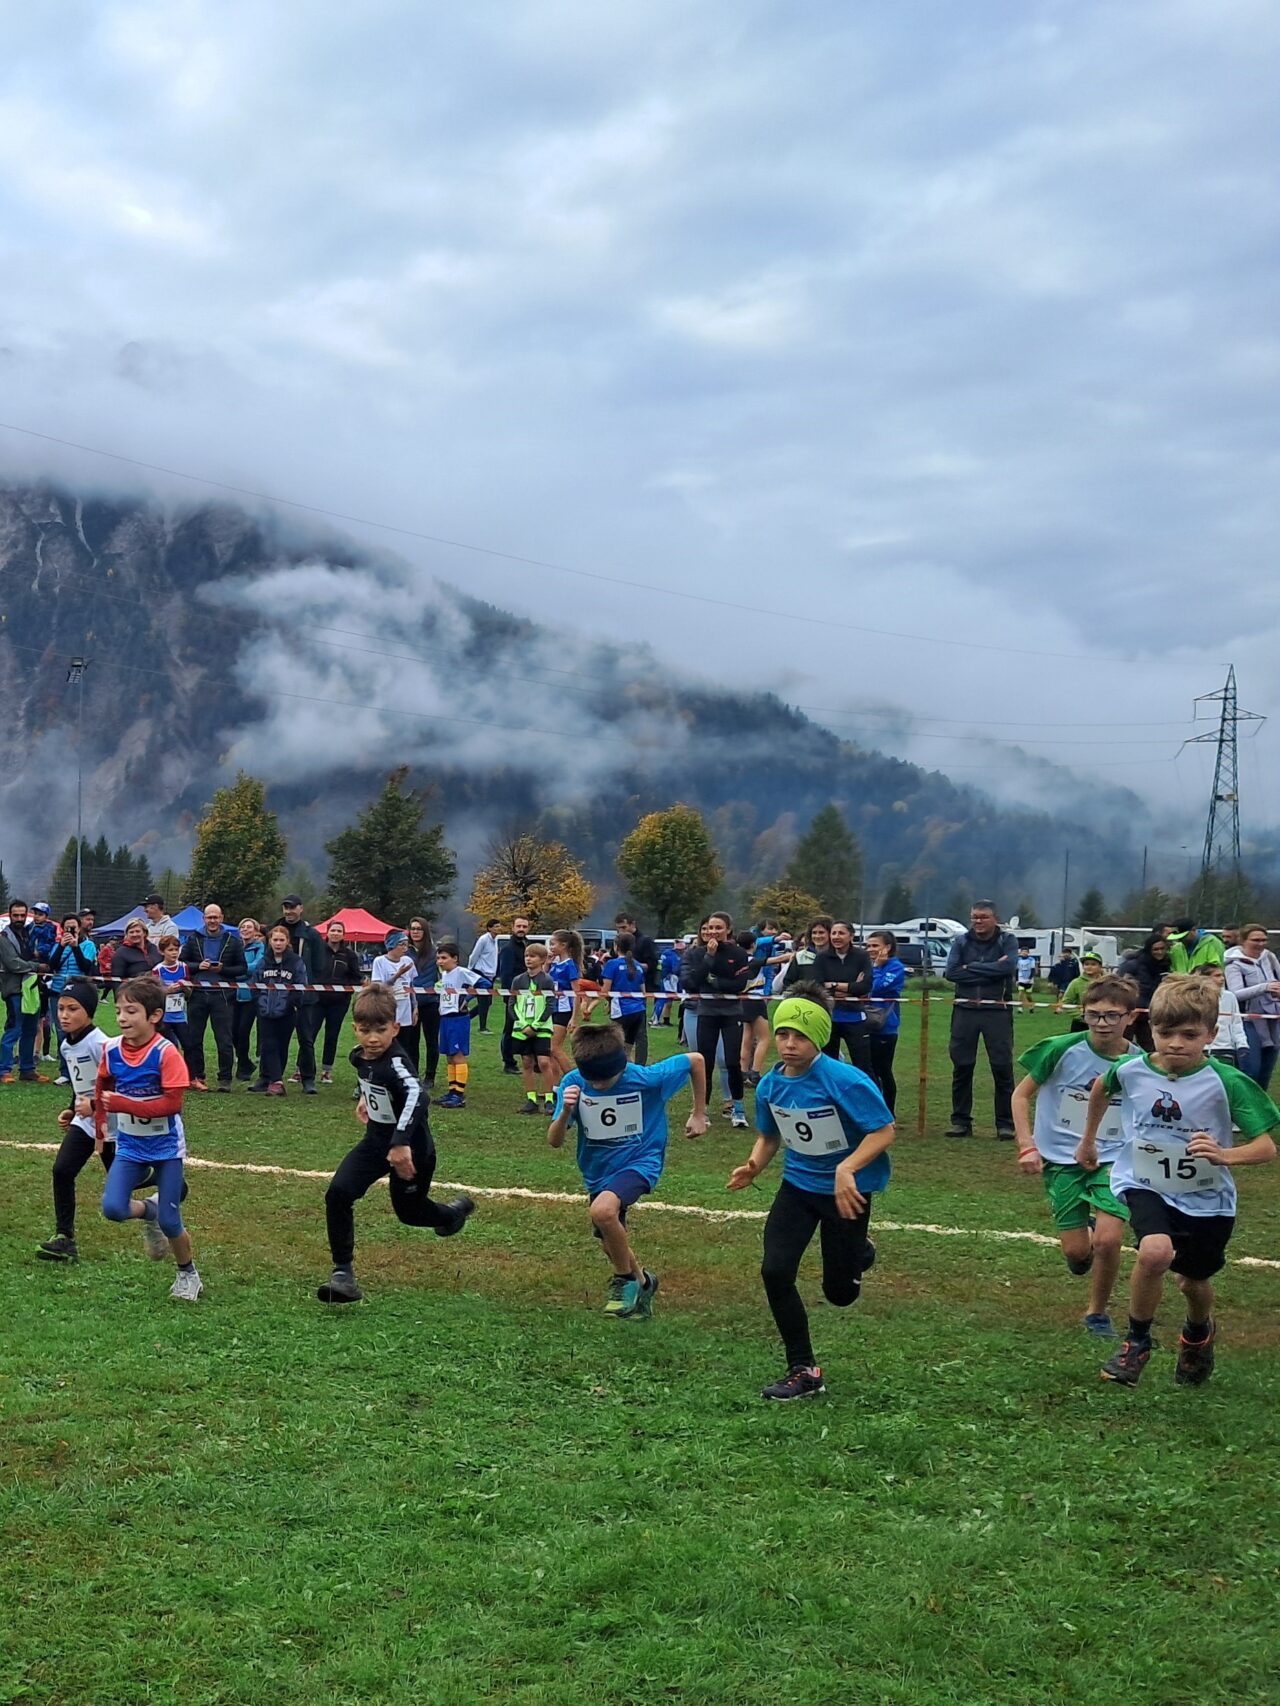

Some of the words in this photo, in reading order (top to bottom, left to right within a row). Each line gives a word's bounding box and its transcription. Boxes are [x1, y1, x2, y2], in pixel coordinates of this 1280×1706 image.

[73, 1065, 83, 1081] 2
[600, 1107, 617, 1127] 6
[795, 1121, 813, 1142] 9
[1157, 1157, 1198, 1180] 15
